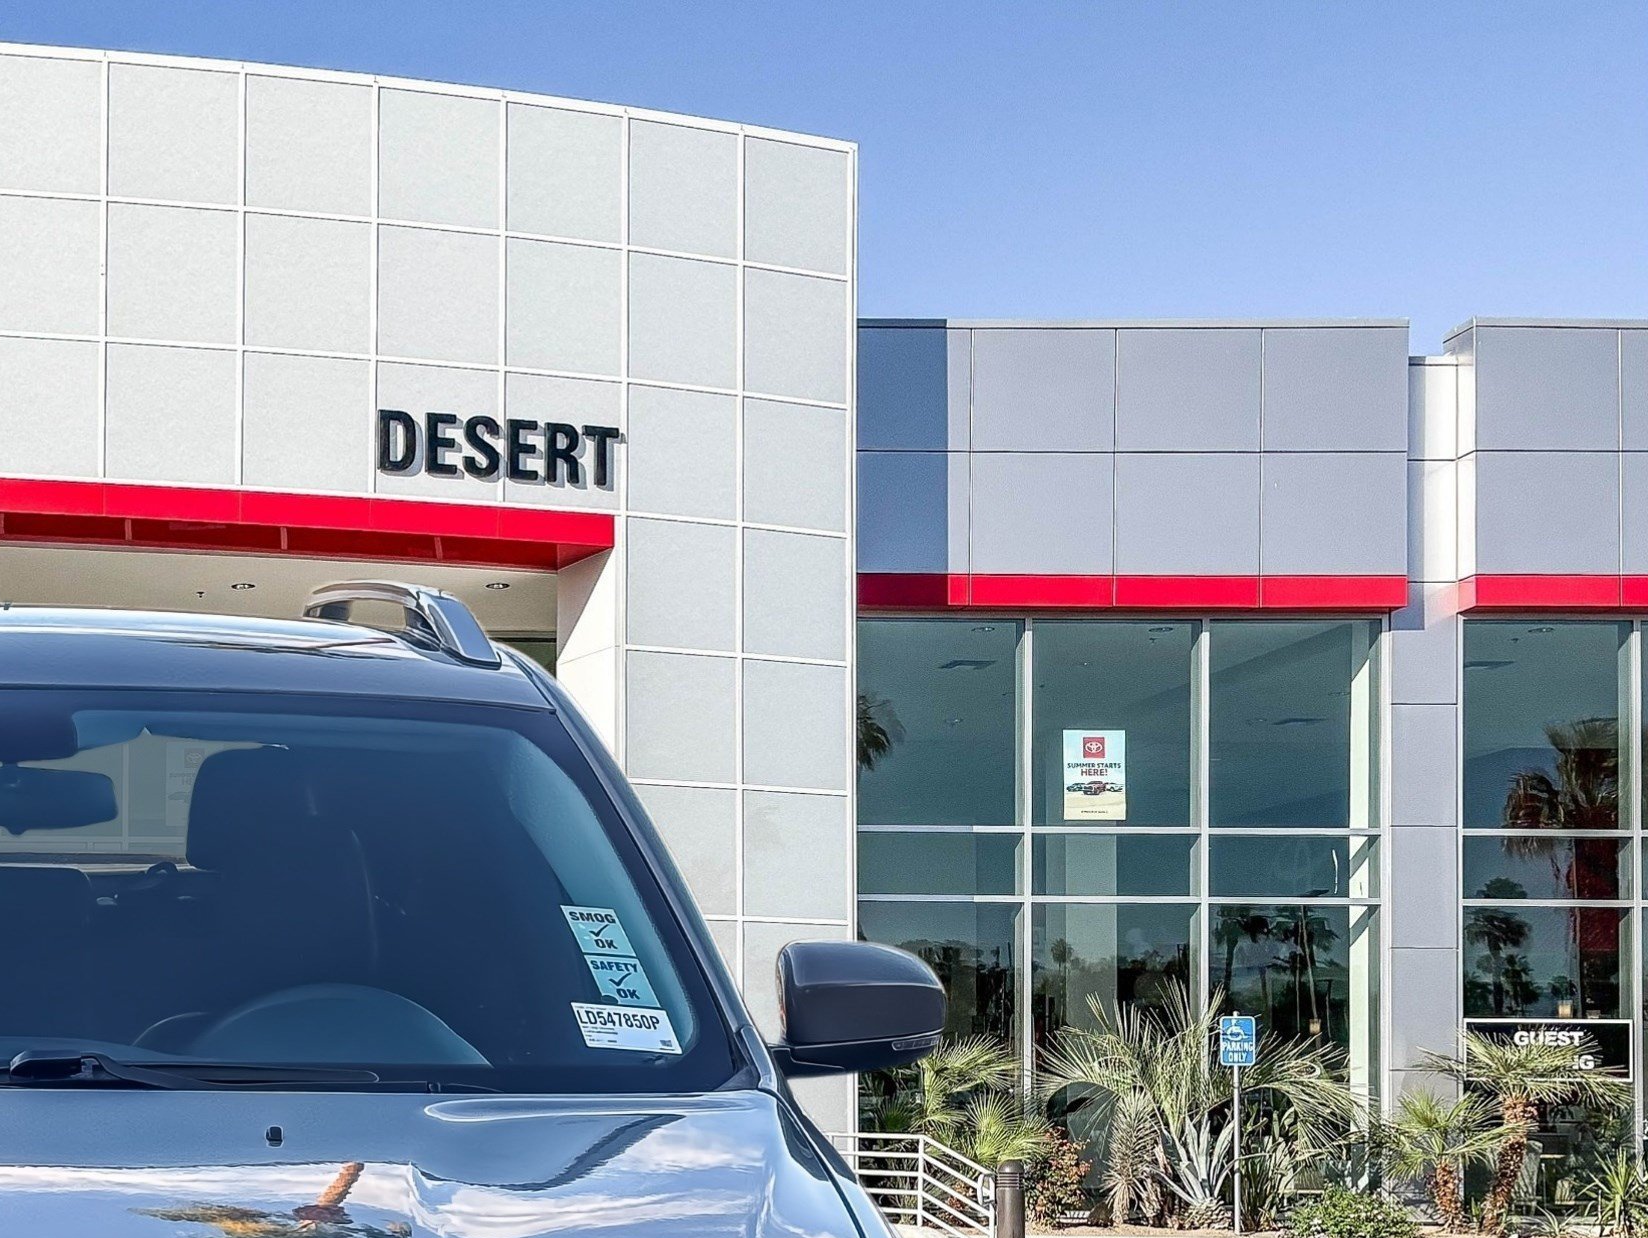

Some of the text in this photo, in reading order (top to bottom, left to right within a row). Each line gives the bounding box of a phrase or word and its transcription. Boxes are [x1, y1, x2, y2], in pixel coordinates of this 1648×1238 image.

[377, 409, 619, 486] DESERT
[569, 911, 616, 924] SMOG
[594, 939, 618, 950] OK
[590, 960, 638, 972] SAFETY
[616, 988, 641, 1000] OK
[577, 1010, 660, 1030] LD547850P
[1513, 1031, 1585, 1047] GUEST
[1222, 1041, 1255, 1051] PARKING
[1228, 1052, 1248, 1062] ONLY
